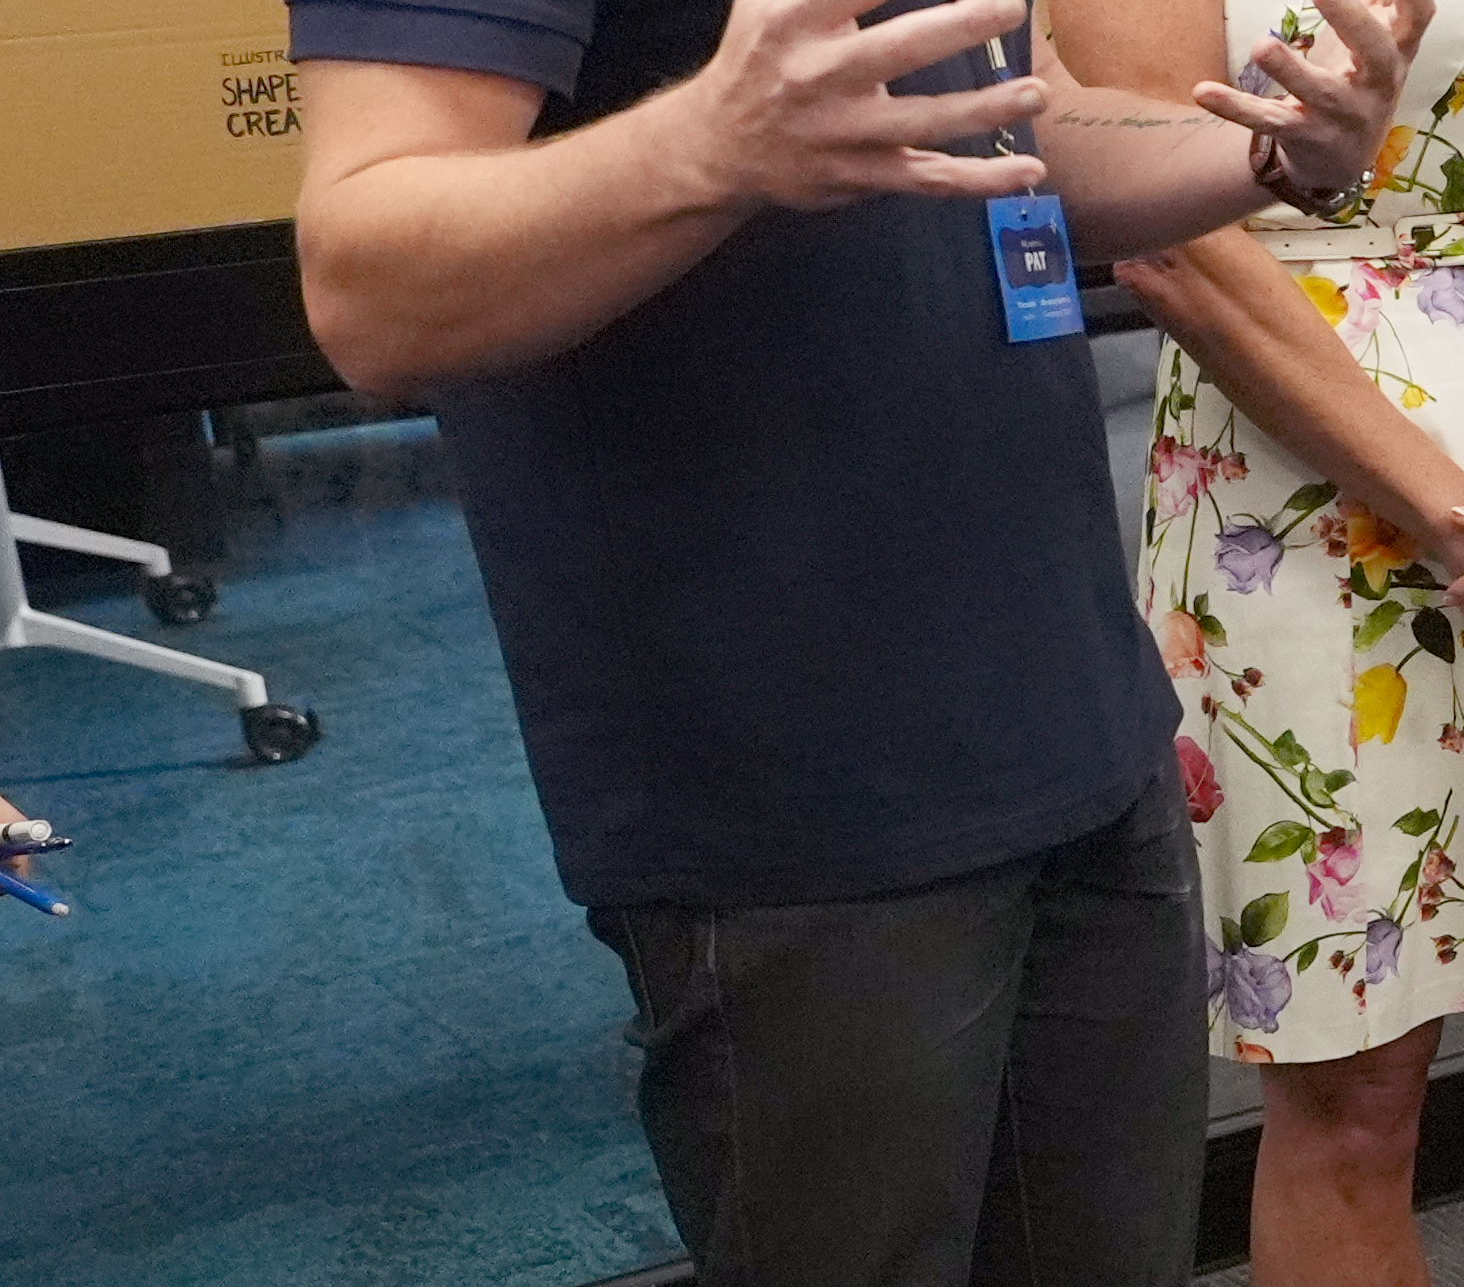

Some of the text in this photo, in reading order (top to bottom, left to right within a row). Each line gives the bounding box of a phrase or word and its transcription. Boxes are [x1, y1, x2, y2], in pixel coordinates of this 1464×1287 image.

[221, 73, 301, 106] SHAPE
[226, 106, 303, 138] CREA
[1024, 250, 1047, 273] PAT
